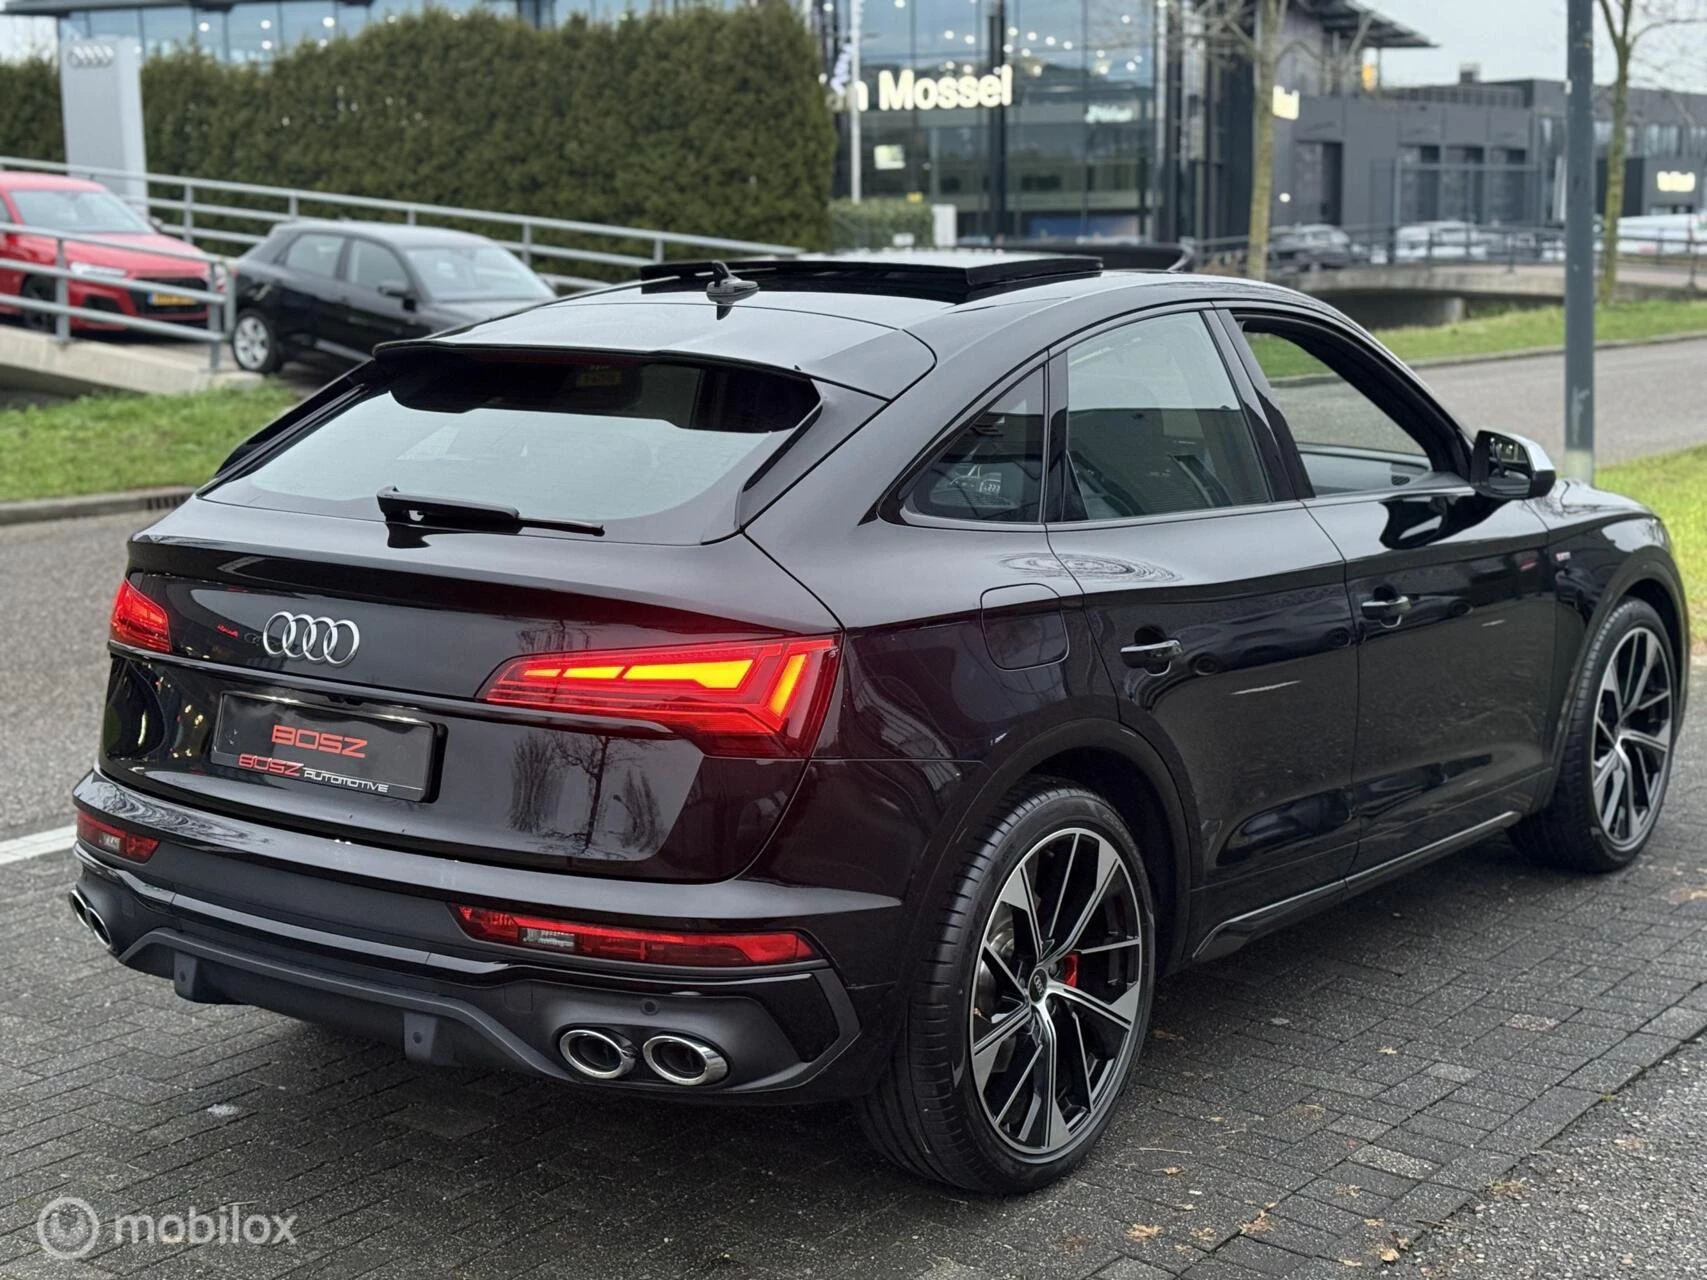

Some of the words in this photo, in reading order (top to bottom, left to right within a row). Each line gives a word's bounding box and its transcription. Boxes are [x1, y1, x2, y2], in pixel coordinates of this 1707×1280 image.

[879, 64, 1013, 111] Mossel
[272, 725, 368, 758] BOSZ
[239, 754, 304, 776] BOSZ
[304, 770, 388, 793] AUTOMOTIVE
